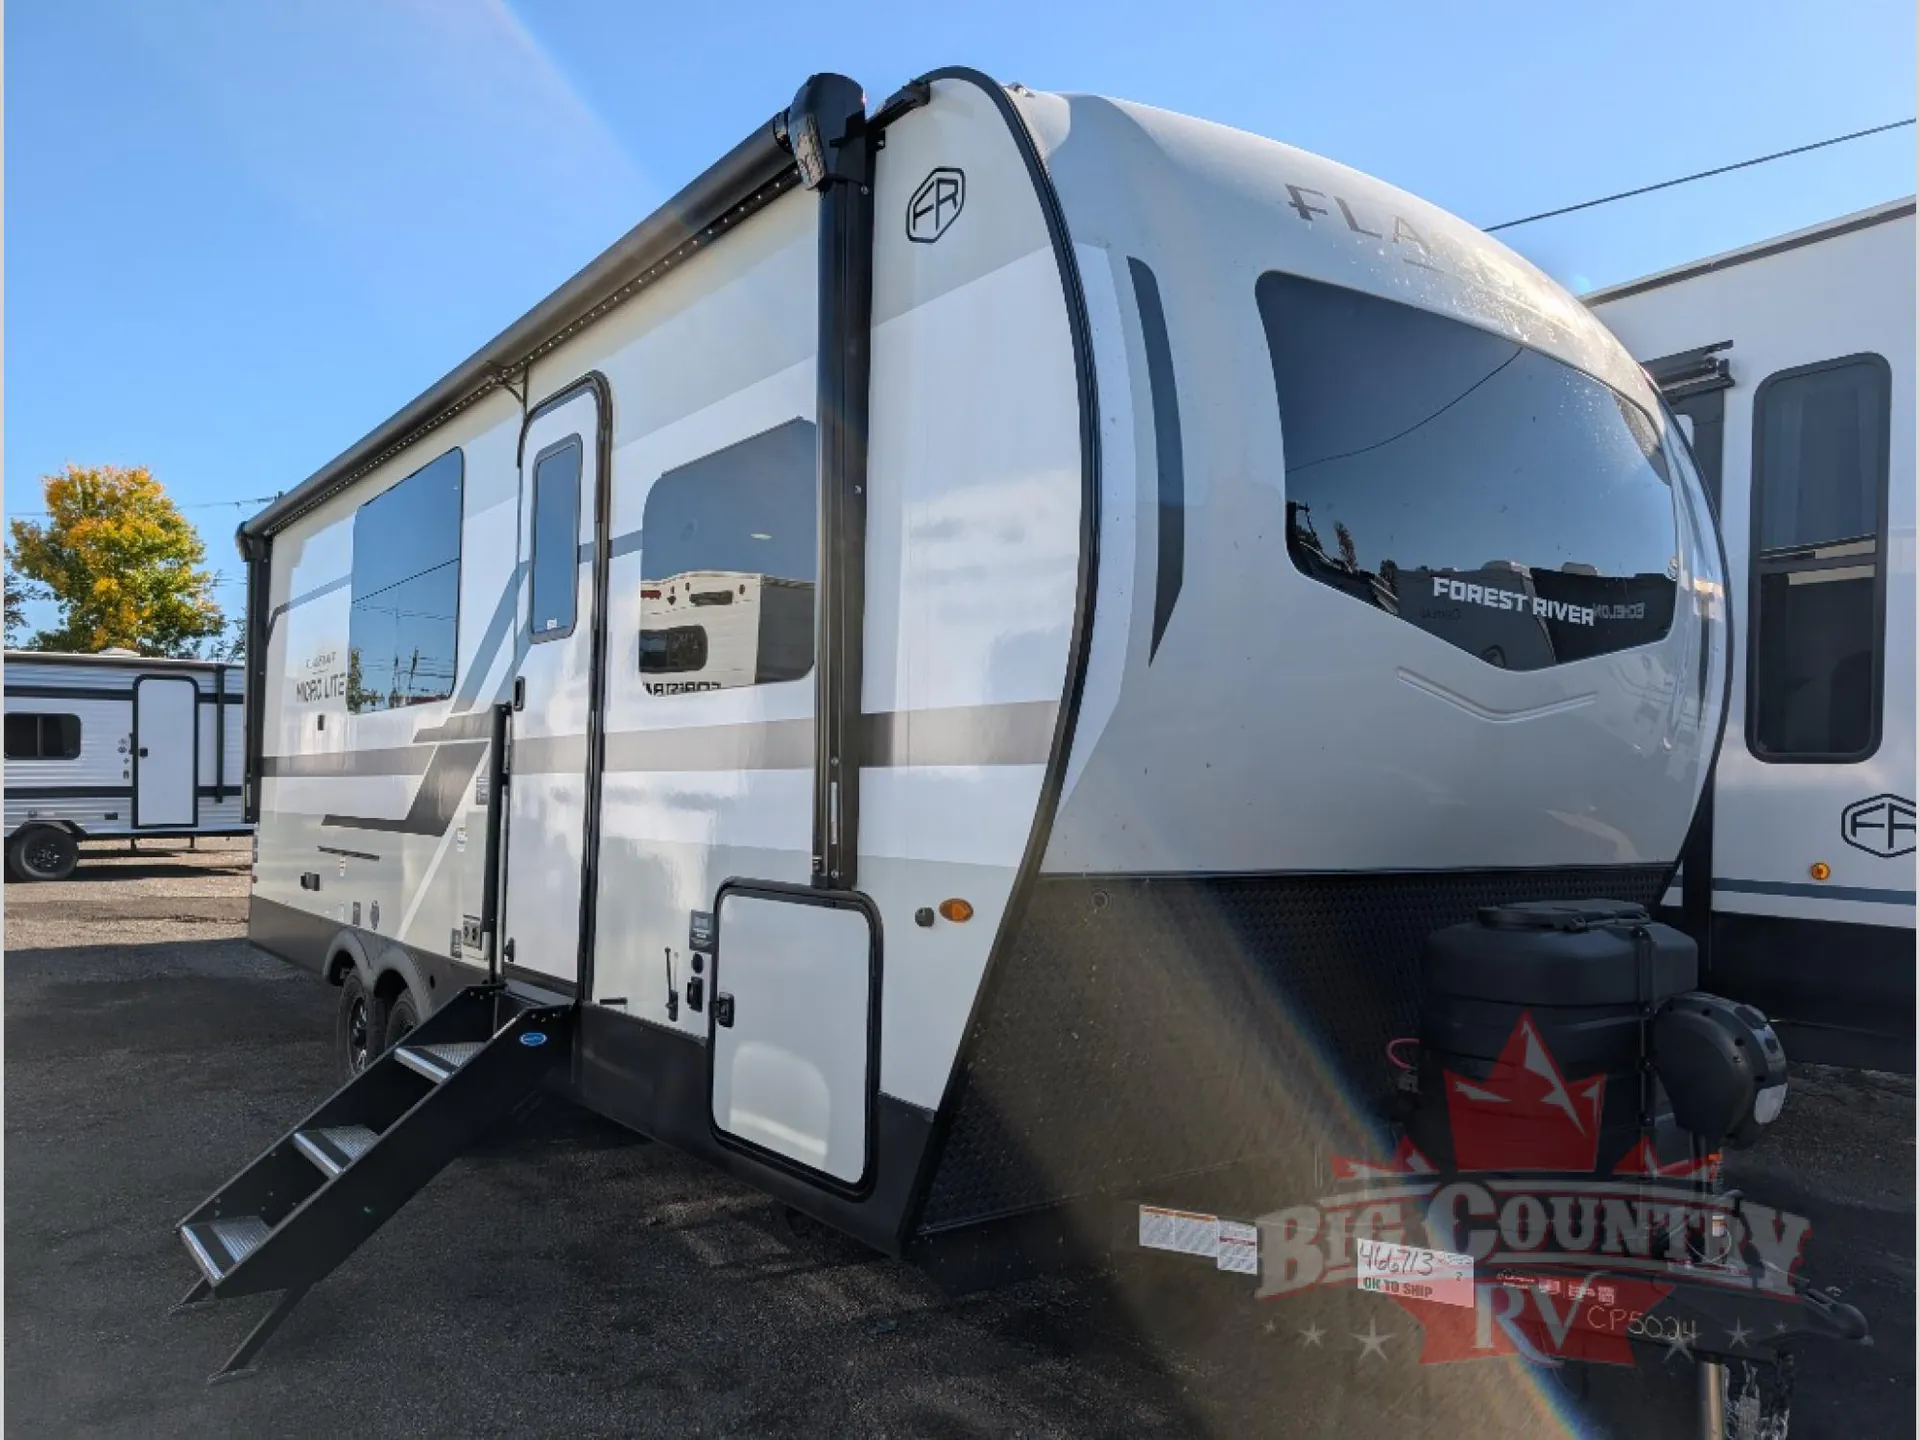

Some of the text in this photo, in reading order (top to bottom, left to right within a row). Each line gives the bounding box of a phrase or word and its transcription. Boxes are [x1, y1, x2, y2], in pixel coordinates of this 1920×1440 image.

[1433, 576, 1595, 627] FOREST RIVER
[296, 671, 346, 703] MICRO LITE
[1363, 1276, 1433, 1298] OK TO SHIP
